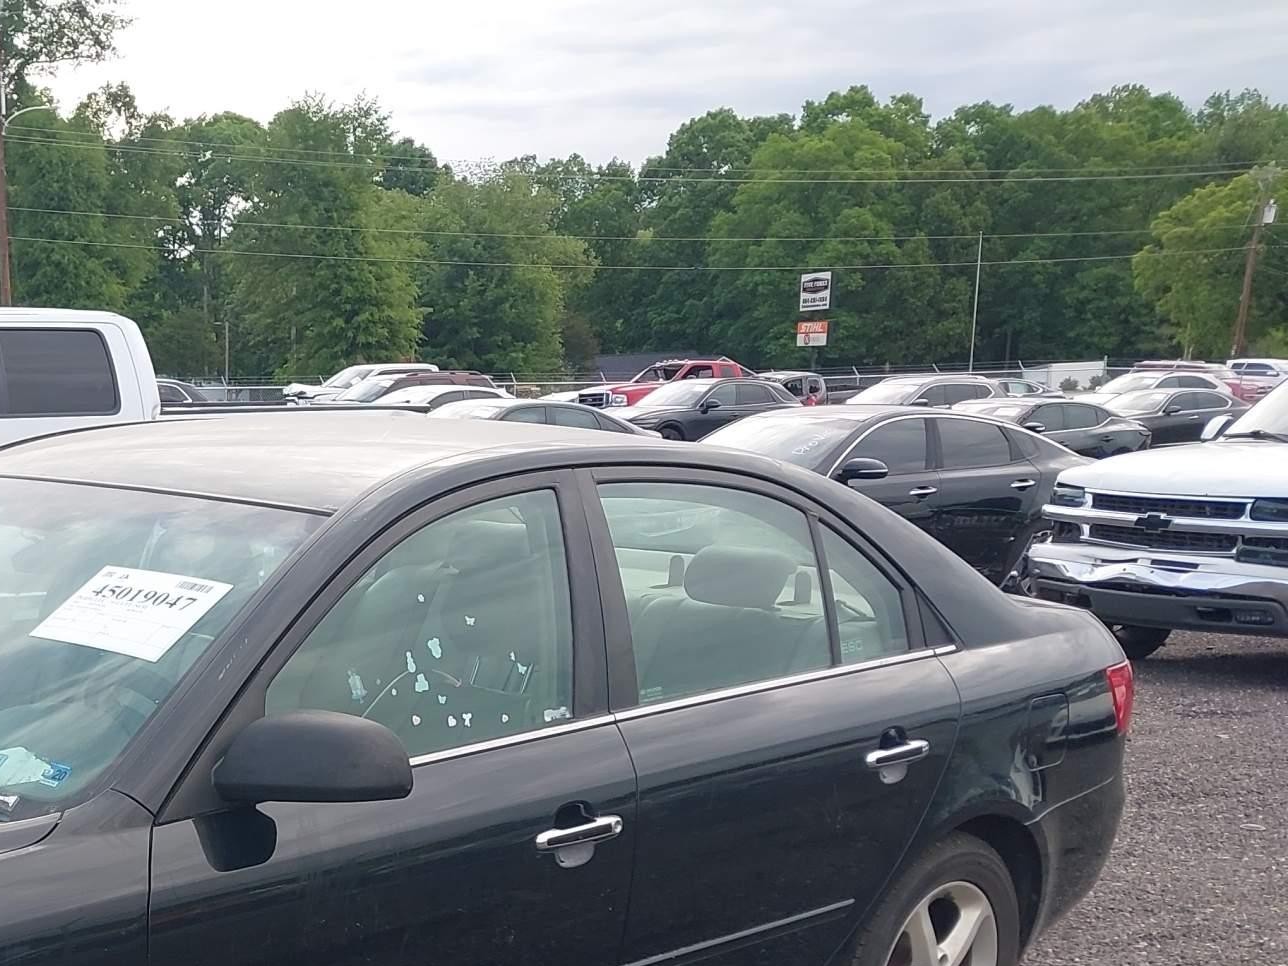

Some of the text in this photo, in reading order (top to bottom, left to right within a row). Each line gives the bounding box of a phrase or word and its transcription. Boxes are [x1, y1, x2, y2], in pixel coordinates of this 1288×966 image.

[801, 322, 823, 332] STIHL
[92, 584, 198, 611] 45019047
[51, 769, 67, 782] 20
